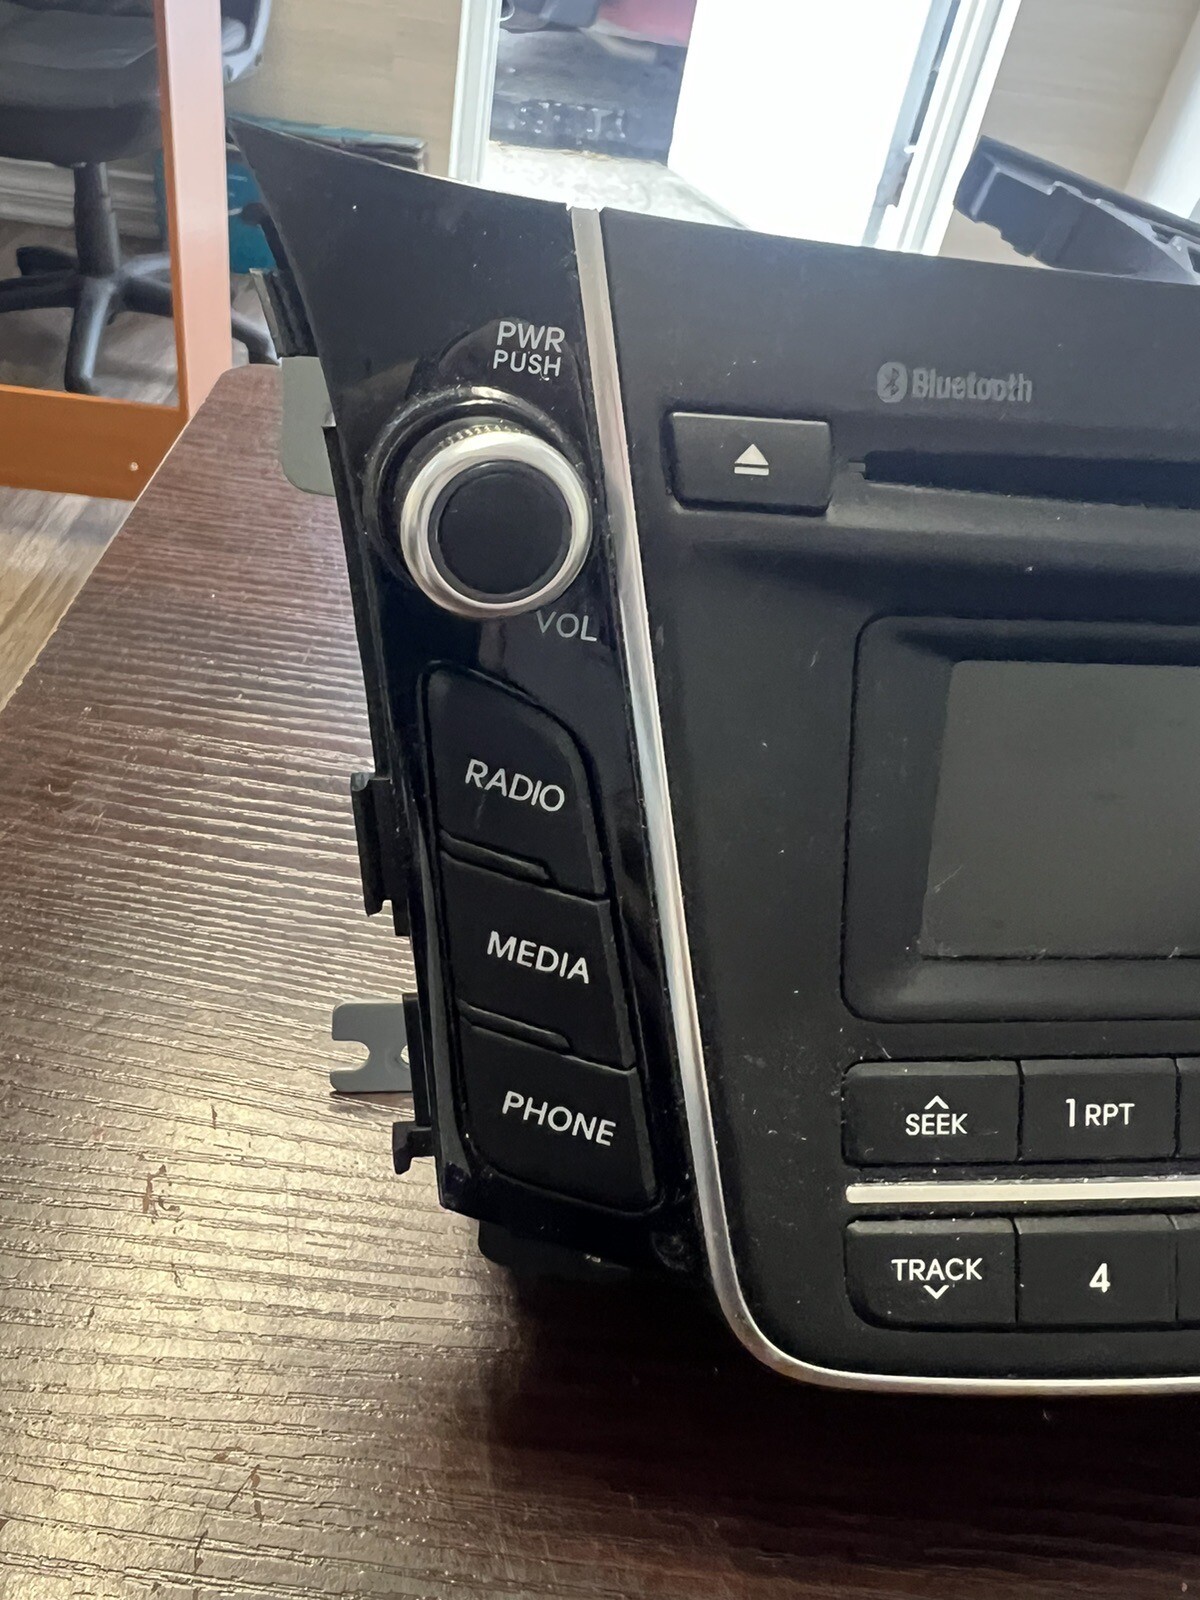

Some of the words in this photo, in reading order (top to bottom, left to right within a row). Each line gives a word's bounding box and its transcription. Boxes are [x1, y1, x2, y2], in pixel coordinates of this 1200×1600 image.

[495, 320, 566, 354] PWR
[492, 349, 563, 377] PUSH
[911, 367, 1034, 403] Bluetooth
[535, 609, 598, 643] VOL
[464, 757, 566, 813] RADIO
[486, 930, 590, 985] MEDIA
[501, 1090, 617, 1147] PHONE
[905, 1112, 968, 1136] SEEK
[1065, 1098, 1076, 1127] 1
[1085, 1102, 1135, 1126] RPT
[891, 1258, 983, 1281] TRACK
[1089, 1262, 1111, 1293] 4
